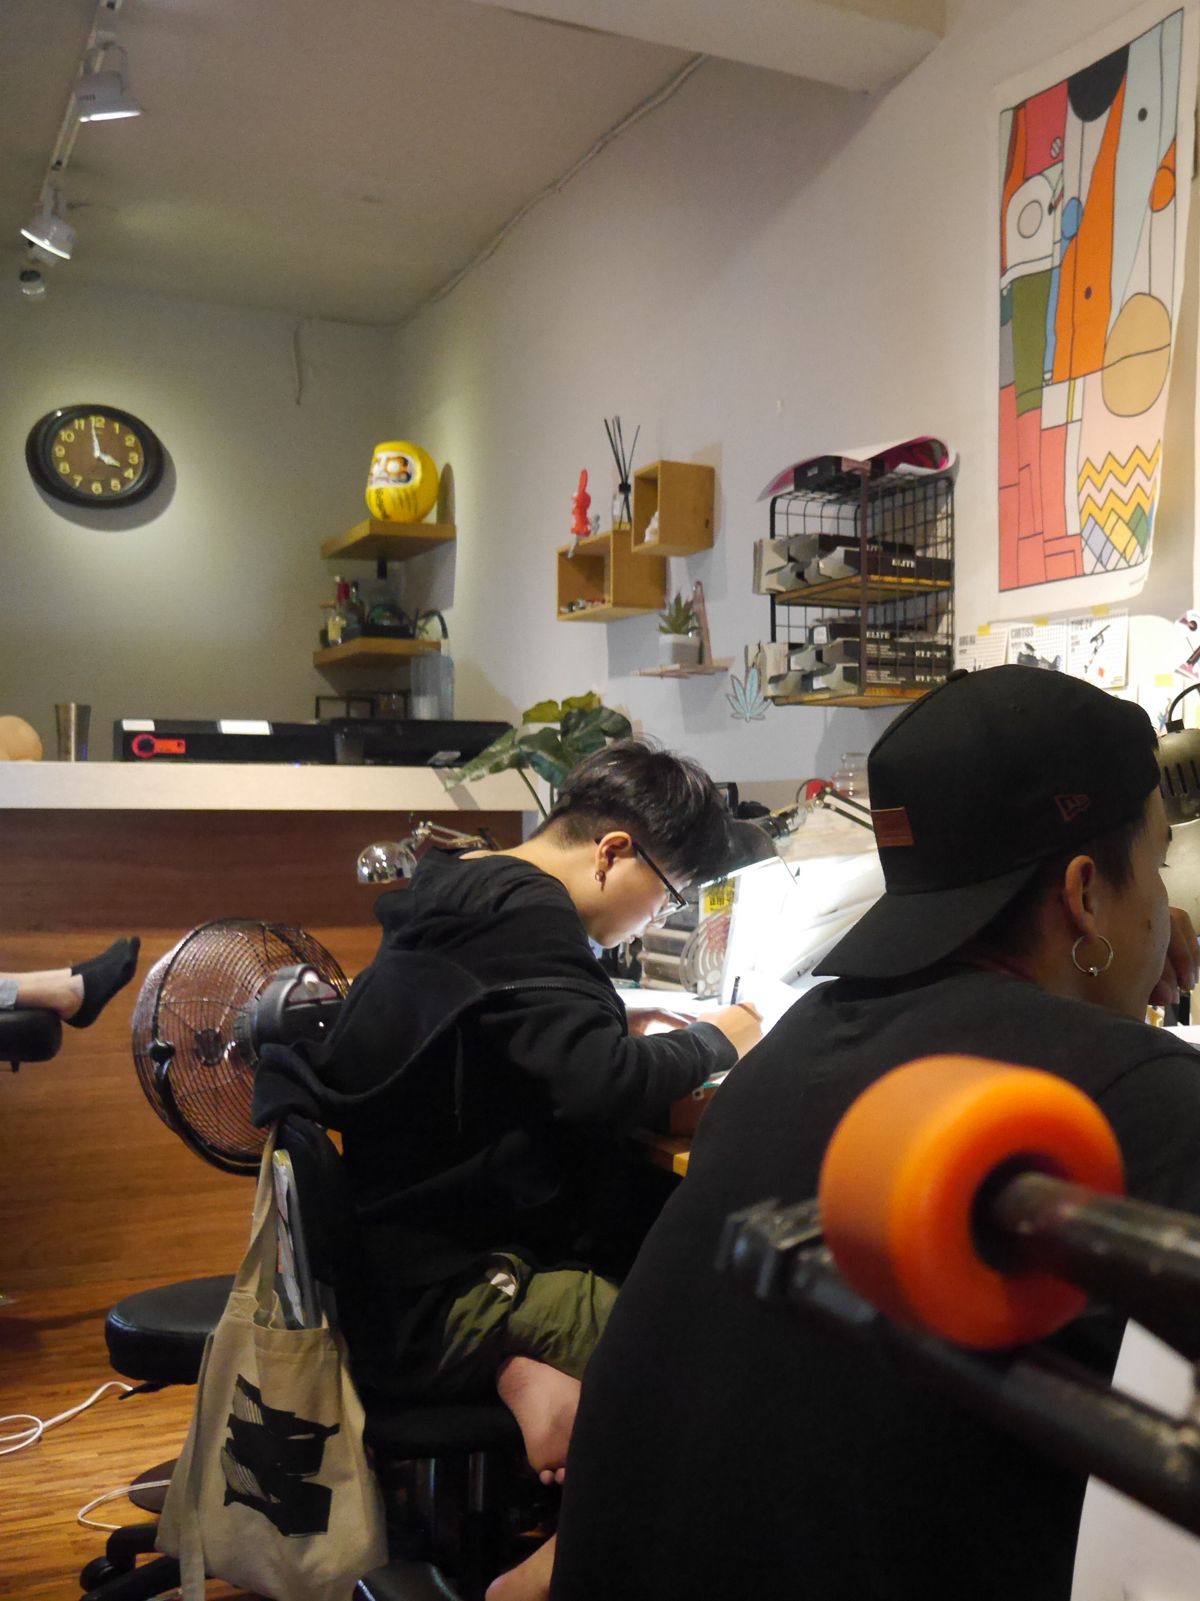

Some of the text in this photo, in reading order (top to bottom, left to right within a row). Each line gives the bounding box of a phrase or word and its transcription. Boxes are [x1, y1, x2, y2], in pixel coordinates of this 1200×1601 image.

[75, 419, 85, 430] 11
[90, 416, 105, 428] 12
[114, 422, 120, 434] 1
[61, 430, 75, 442] 10
[124, 468, 134, 479] 4
[73, 474, 83, 487] 7
[866, 631, 890, 639] ELITE
